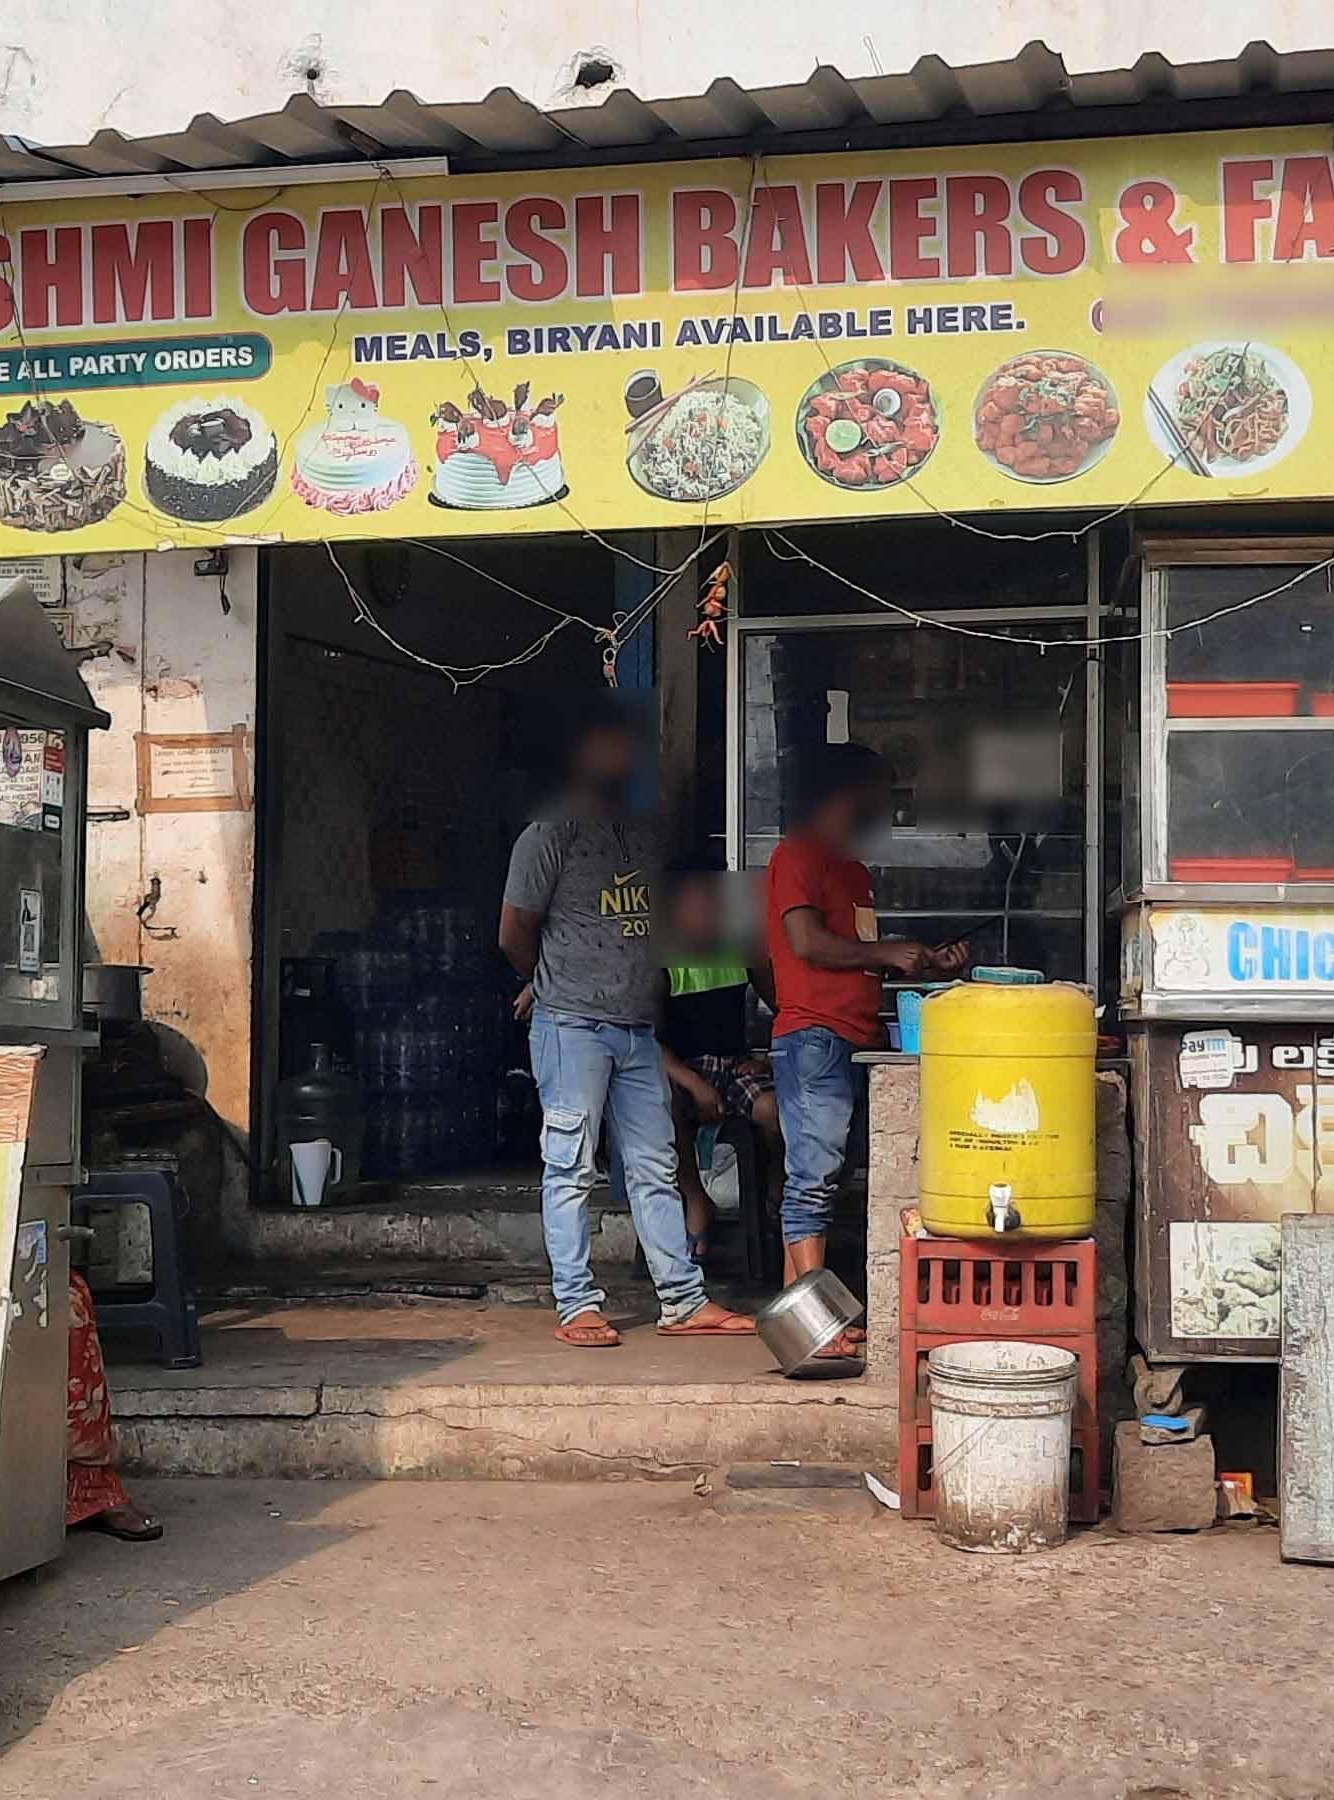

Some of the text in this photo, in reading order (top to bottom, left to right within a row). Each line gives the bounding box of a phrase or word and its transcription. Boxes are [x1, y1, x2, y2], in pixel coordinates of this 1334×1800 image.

[242, 193, 643, 315] GANESH
[672, 171, 1086, 292] BAKERS
[1115, 181, 1195, 262] &
[354, 302, 1027, 364] MEALS, BIRYANI AVAILABLE HERE.
[17, 359, 62, 379] ALL
[69, 352, 145, 376] PARTY
[153, 345, 253, 371] ORDERS
[600, 886, 650, 915] NIK
